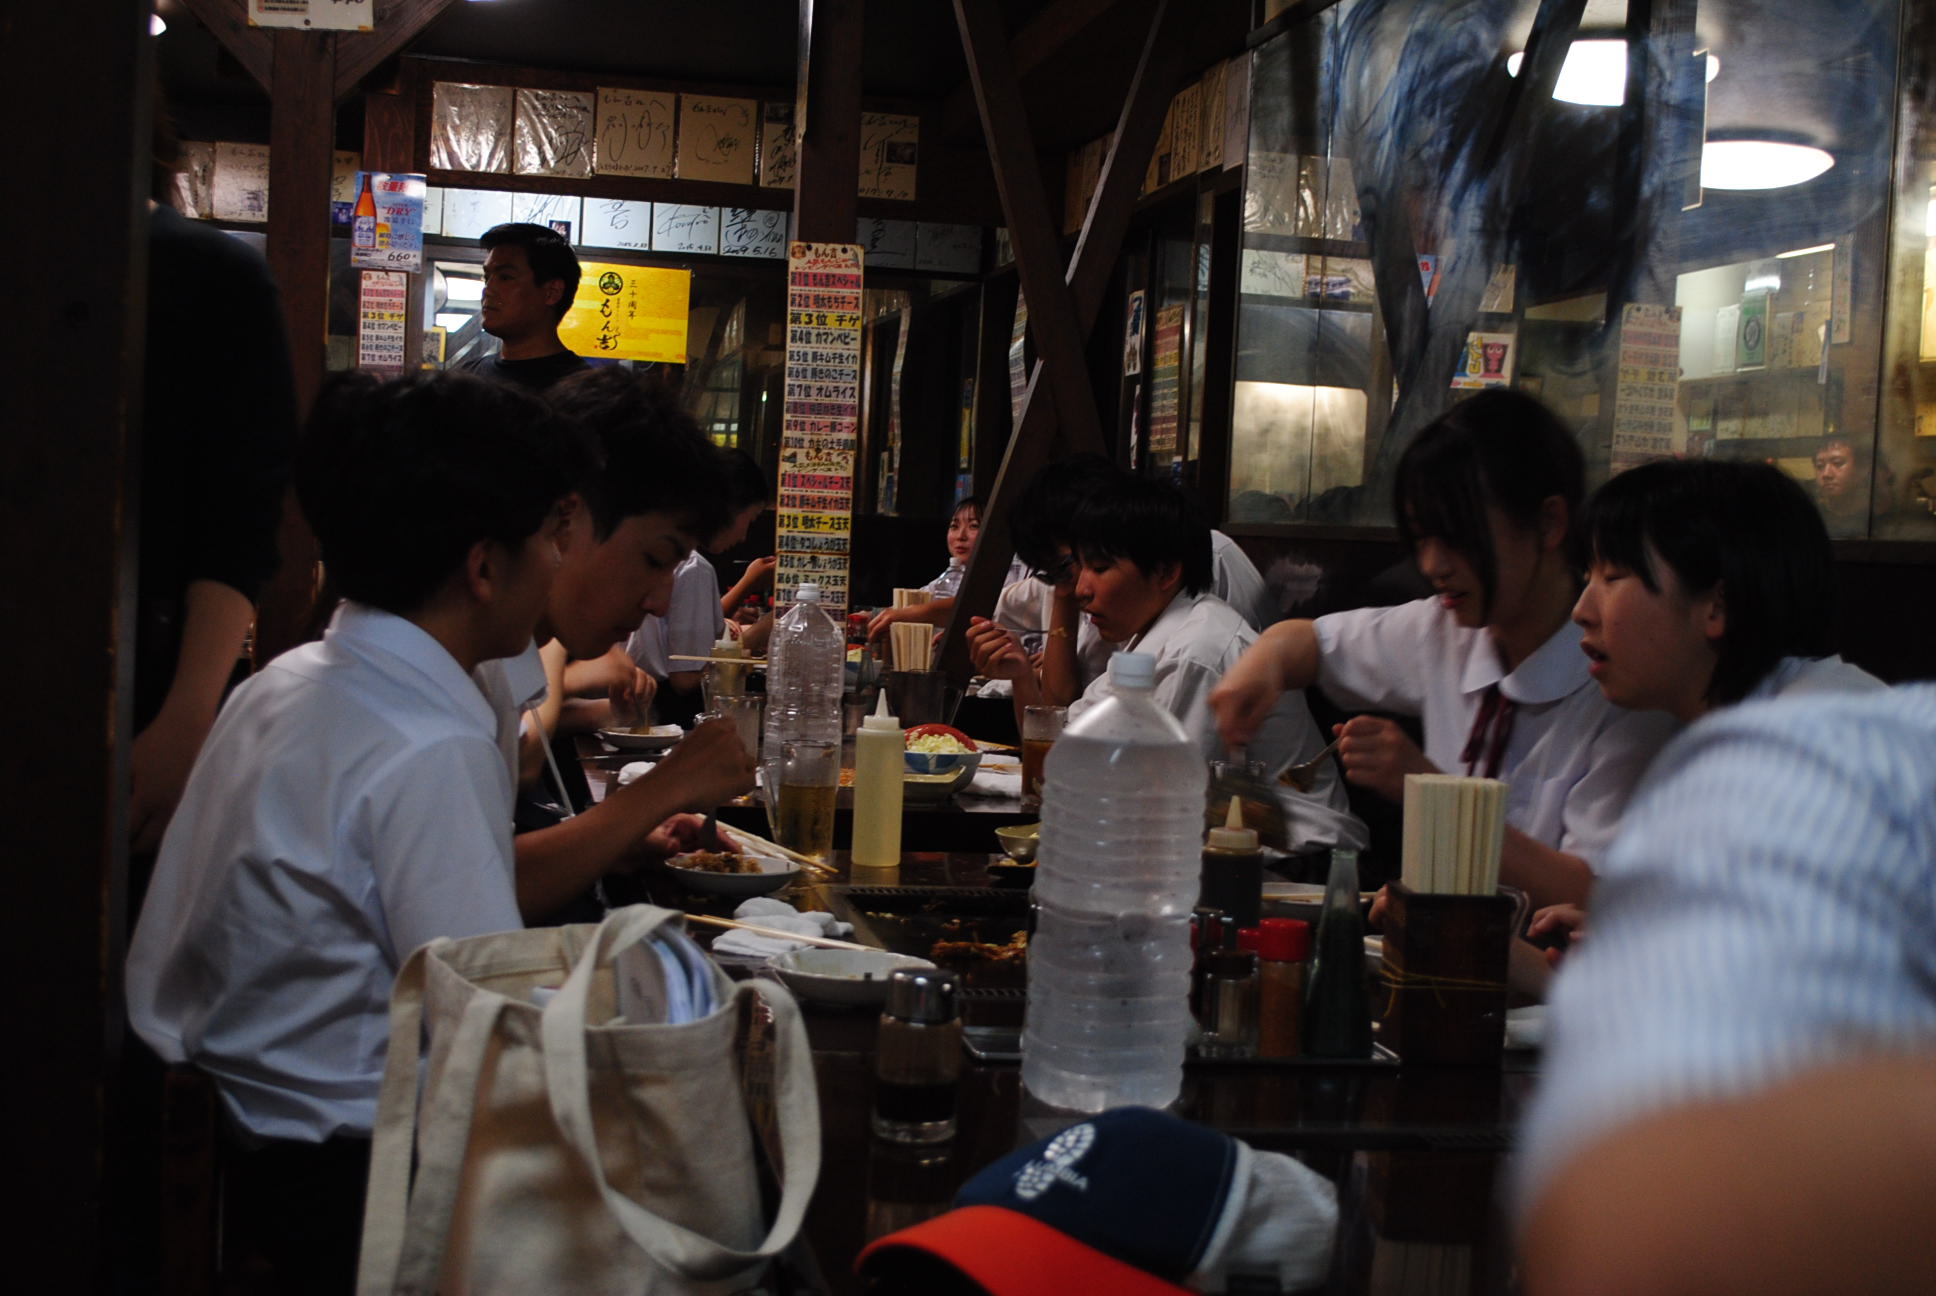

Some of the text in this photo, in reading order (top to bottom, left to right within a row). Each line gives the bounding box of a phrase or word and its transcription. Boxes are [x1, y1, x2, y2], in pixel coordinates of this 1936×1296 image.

[790, 313, 860, 327] 第3位 チゲ
[791, 330, 812, 344] 第4位
[789, 350, 808, 363] 第5位
[788, 367, 808, 379] 第6位
[787, 384, 856, 399] 第7位 オムライス
[785, 420, 806, 432] 第9位
[784, 436, 805, 449] 第10位
[779, 514, 799, 528] 第3位
[778, 573, 847, 586] 第6位 ミックス玉天
